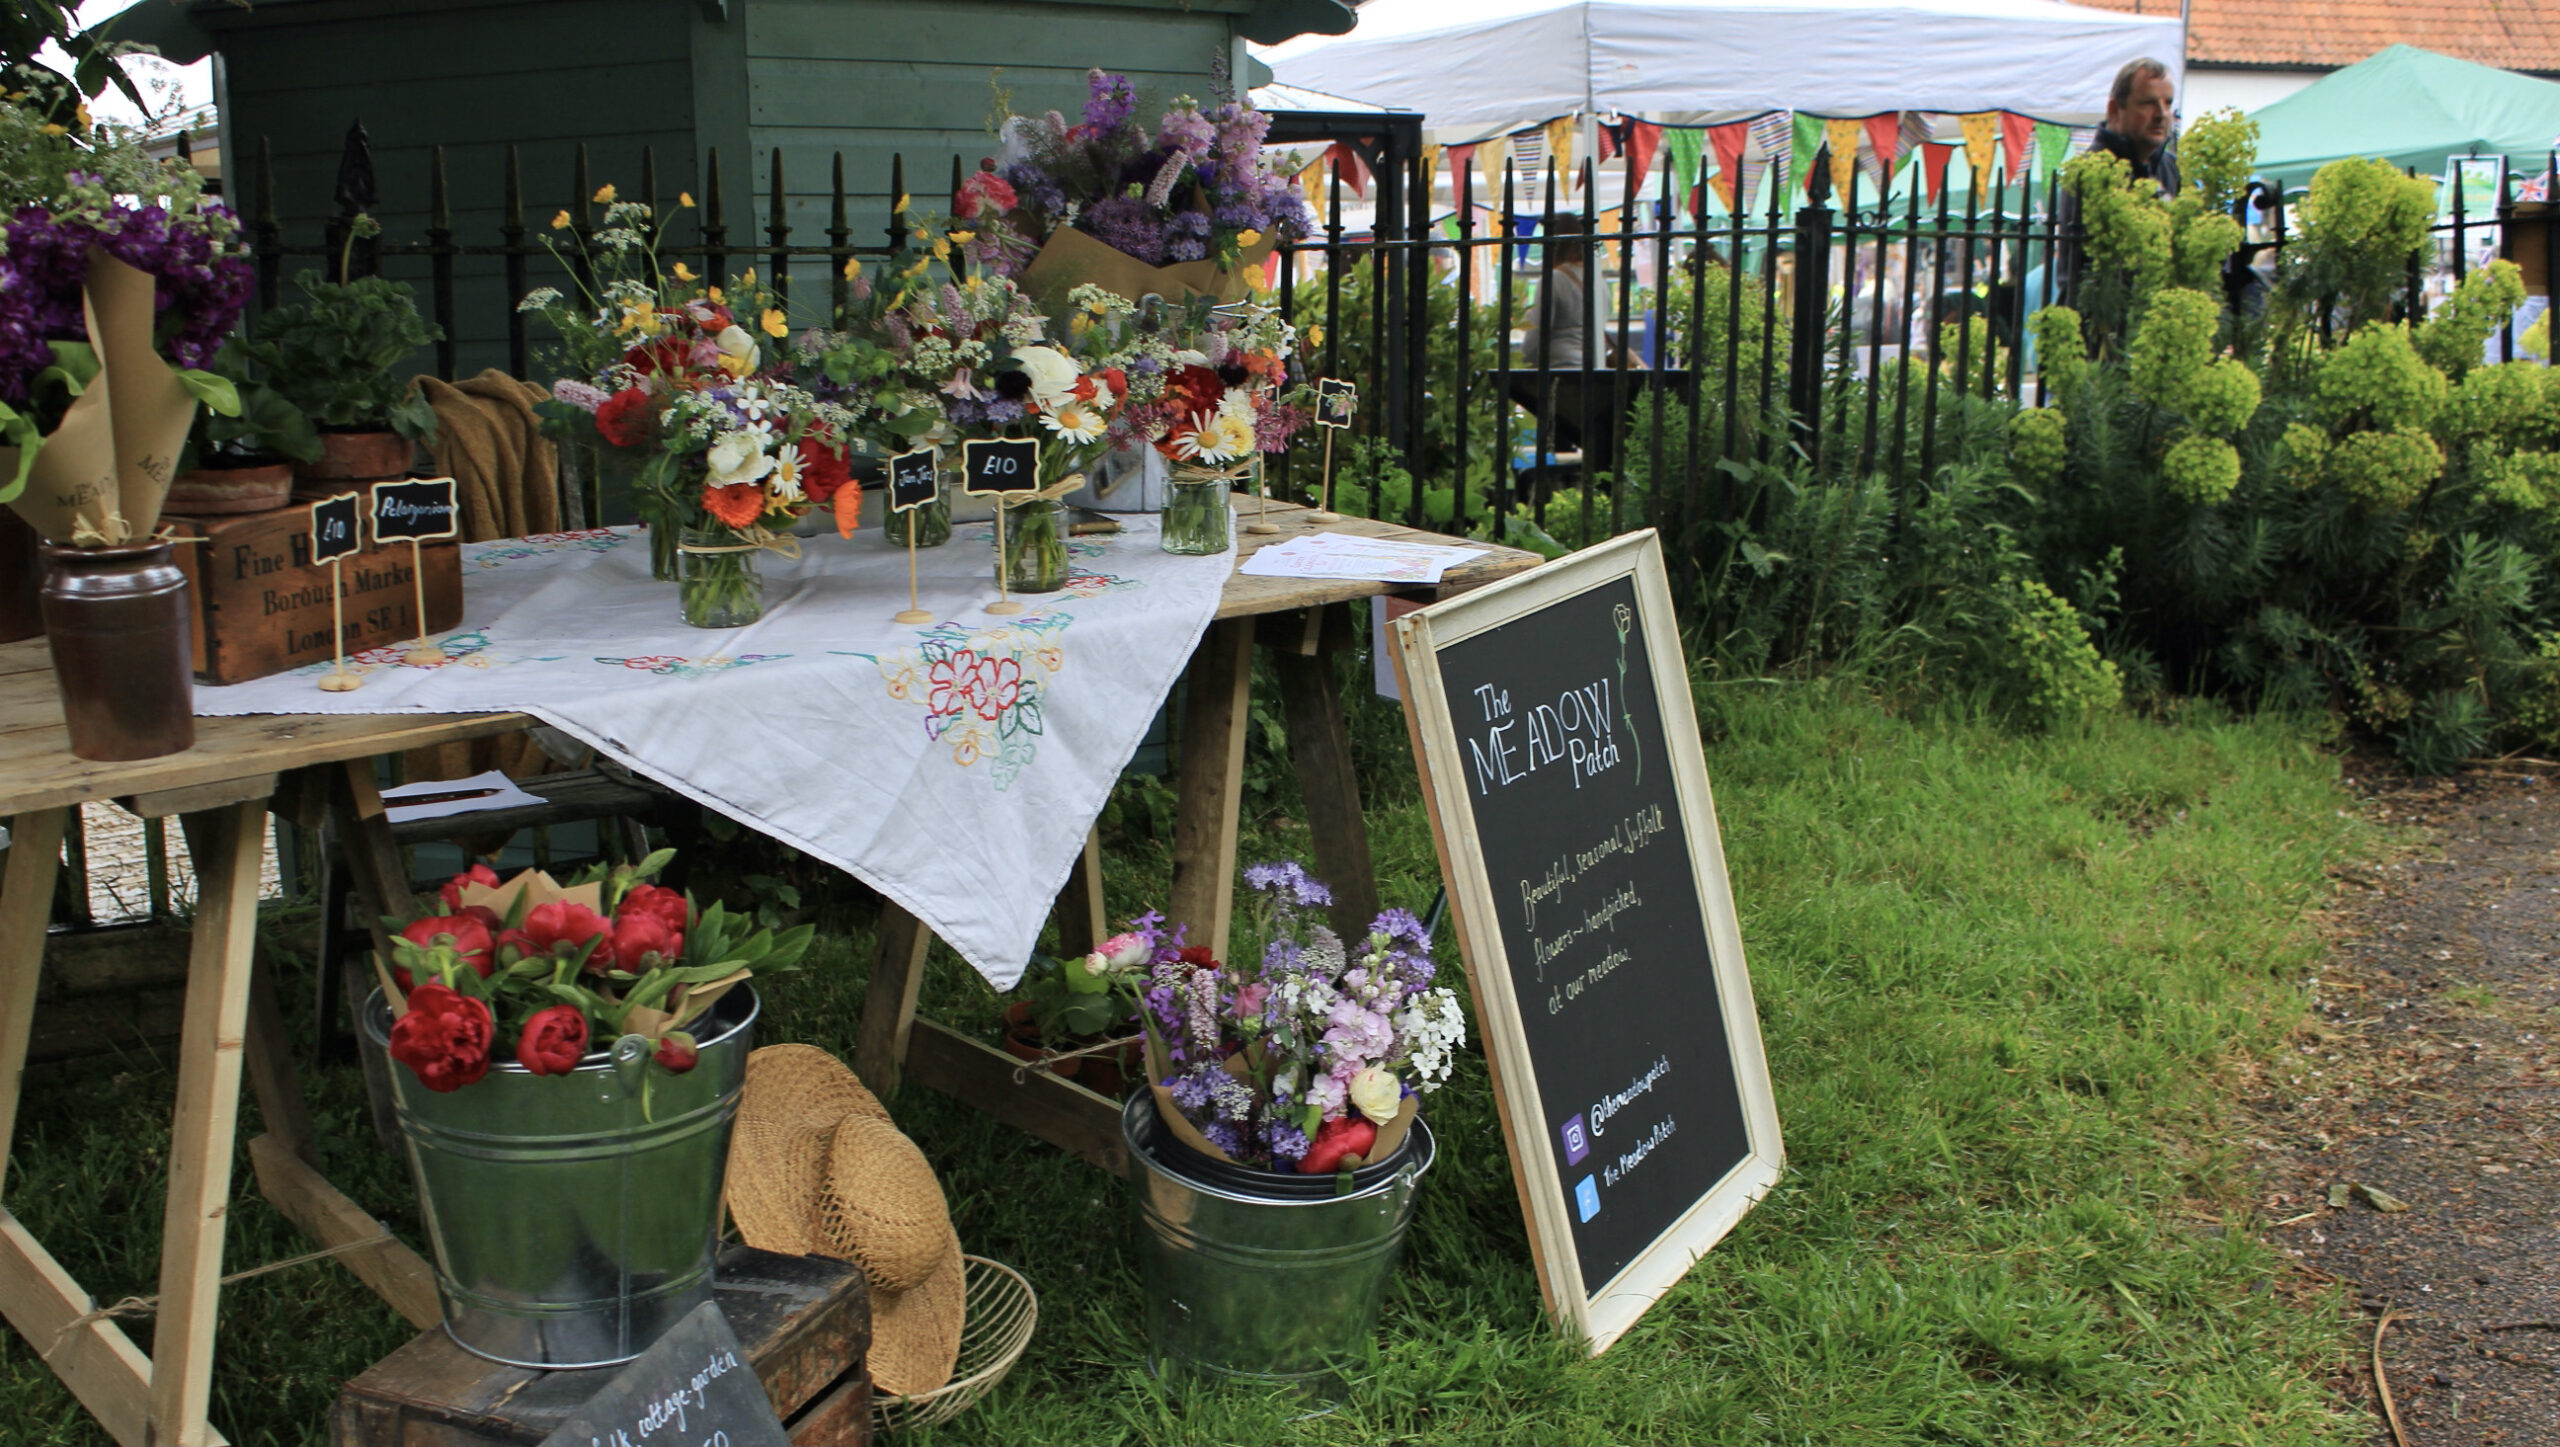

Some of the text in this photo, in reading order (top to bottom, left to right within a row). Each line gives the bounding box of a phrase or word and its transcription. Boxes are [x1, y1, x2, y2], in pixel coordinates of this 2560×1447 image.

[981, 455, 1017, 475] £10
[322, 516, 346, 542] £10
[233, 543, 285, 581] Fine
[353, 562, 413, 594] Marke
[366, 606, 391, 634] SE
[1474, 682, 1512, 722] The
[1468, 678, 1612, 796] MEADOW
[1568, 734, 1621, 789] Patch
[1520, 853, 1577, 933] Beautiful,
[1624, 803, 1666, 854] Suffolk
[1548, 984, 1564, 1015] at
[1565, 974, 1585, 1001] our
[1590, 1054, 1671, 1137] @themeadowpatch
[1603, 1164, 1621, 1188] The
[638, 1351, 739, 1438] cottage-garden
